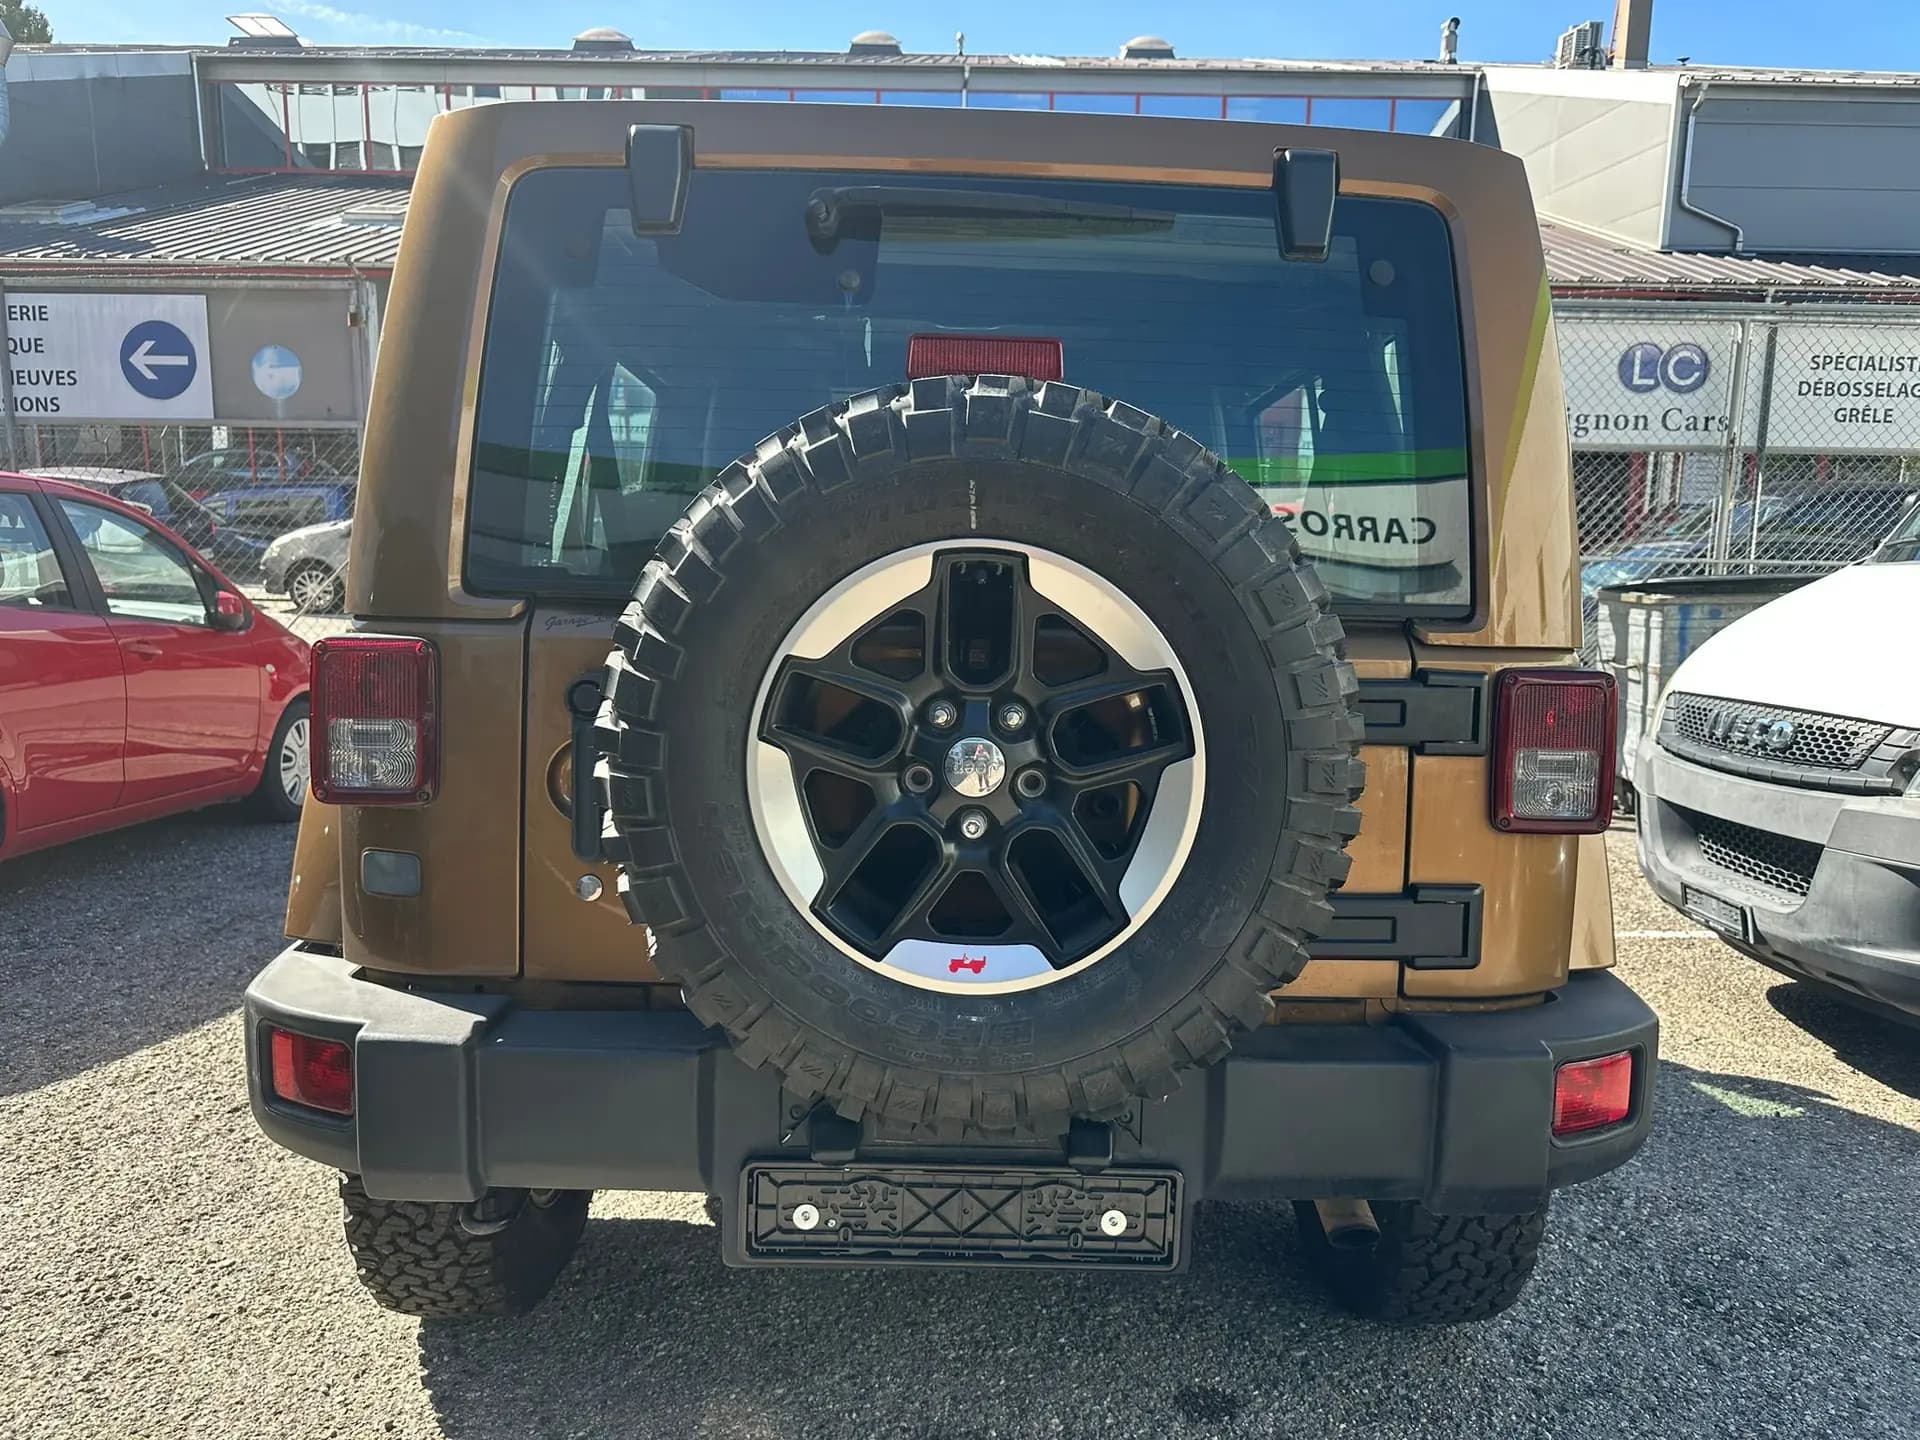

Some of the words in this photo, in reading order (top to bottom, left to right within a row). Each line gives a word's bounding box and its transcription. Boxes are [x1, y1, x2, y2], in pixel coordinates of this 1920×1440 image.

[7, 304, 48, 321] ERIE
[7, 337, 45, 355] QUE
[1809, 352, 1920, 372] SPÉCIALIST
[1661, 407, 1729, 432] Cars
[1834, 404, 1894, 423] GRÊLE
